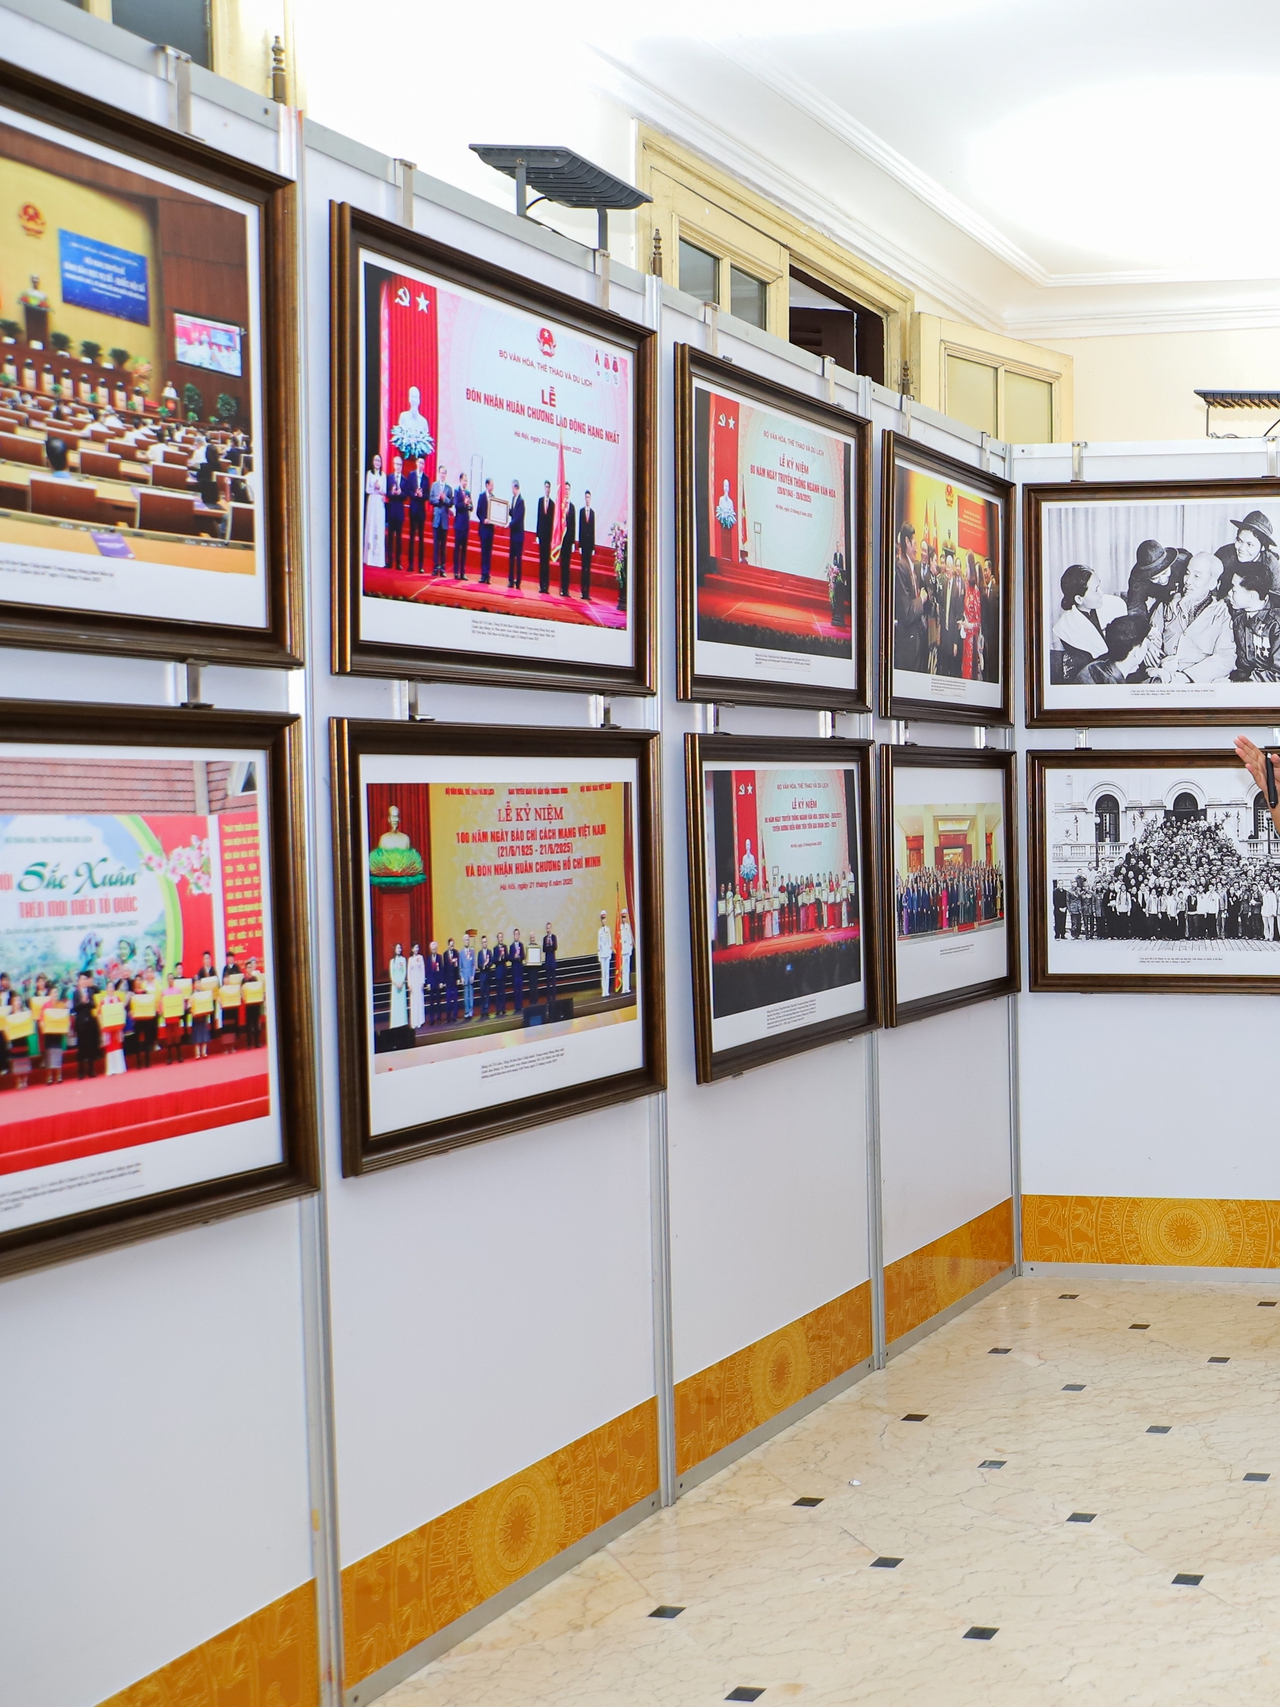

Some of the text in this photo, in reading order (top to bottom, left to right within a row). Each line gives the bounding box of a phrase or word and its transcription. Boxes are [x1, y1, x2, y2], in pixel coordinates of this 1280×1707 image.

[509, 352, 521, 363] VĂN
[549, 366, 564, 378] THAO
[564, 370, 572, 381] VÀ
[573, 374, 580, 384] DU
[541, 386, 556, 408] LỄ
[466, 387, 482, 403] ĐÓN
[484, 393, 504, 411] NHẬN
[506, 400, 525, 416] HUÂN
[527, 406, 554, 425] CHƯƠNG
[569, 418, 586, 434] ĐỘNG
[588, 425, 604, 440] HẠNG
[605, 429, 620, 444] NHẤT
[498, 801, 512, 822] LỄ
[534, 804, 564, 824] NIỆM
[456, 824, 606, 843] 100 NĂM NGÀY BÁO CHÍ CÁCH MẠNG VIỆT NAM
[17, 861, 68, 892] Sắc
[73, 857, 138, 895] Xuân
[465, 863, 475, 877] VÀ
[494, 861, 513, 877] NHẬN
[515, 860, 533, 874] HUÂN
[535, 859, 561, 873] CHƯƠNG
[573, 856, 583, 869] CHÍ
[585, 856, 601, 868] MINH
